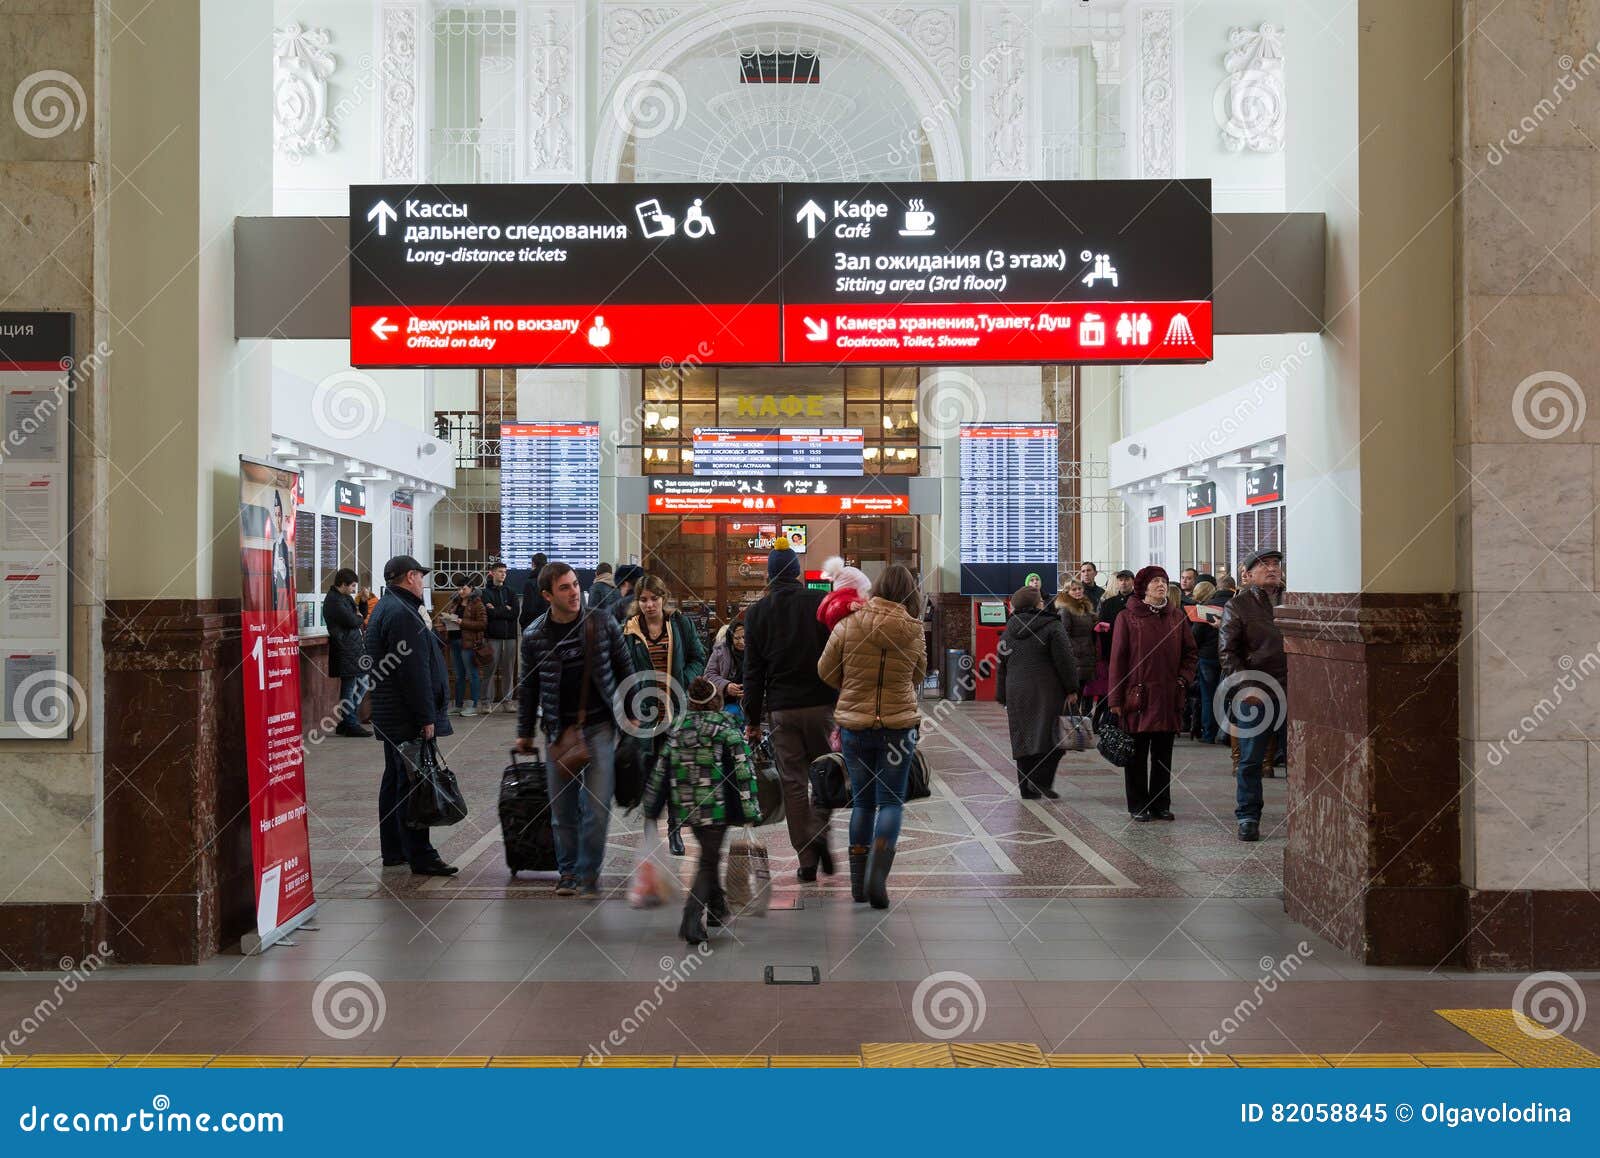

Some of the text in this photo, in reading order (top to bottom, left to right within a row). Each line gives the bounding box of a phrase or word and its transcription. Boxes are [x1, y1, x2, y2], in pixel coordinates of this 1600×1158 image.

[405, 199, 467, 218] Кассы
[834, 200, 888, 222] Кафе
[405, 224, 627, 243] дальнего следования
[834, 223, 871, 239] Café
[406, 247, 567, 265] Long-distance tickets
[834, 249, 1067, 271] Зал ожидания (3 этаж)
[835, 275, 1007, 295] Sitting area (3rd floor)
[406, 316, 580, 334] Дежурный по вокзалу
[836, 316, 896, 332] Камера
[1037, 315, 1071, 332] Душ
[406, 335, 497, 350] Official on duty
[836, 335, 980, 349] Cloakroom, Toilet, Shower
[738, 394, 824, 417] КАФЕ
[299, 475, 304, 494] 9
[795, 480, 813, 488] Кафе
[1272, 471, 1278, 490] 2
[252, 636, 265, 690] 1
